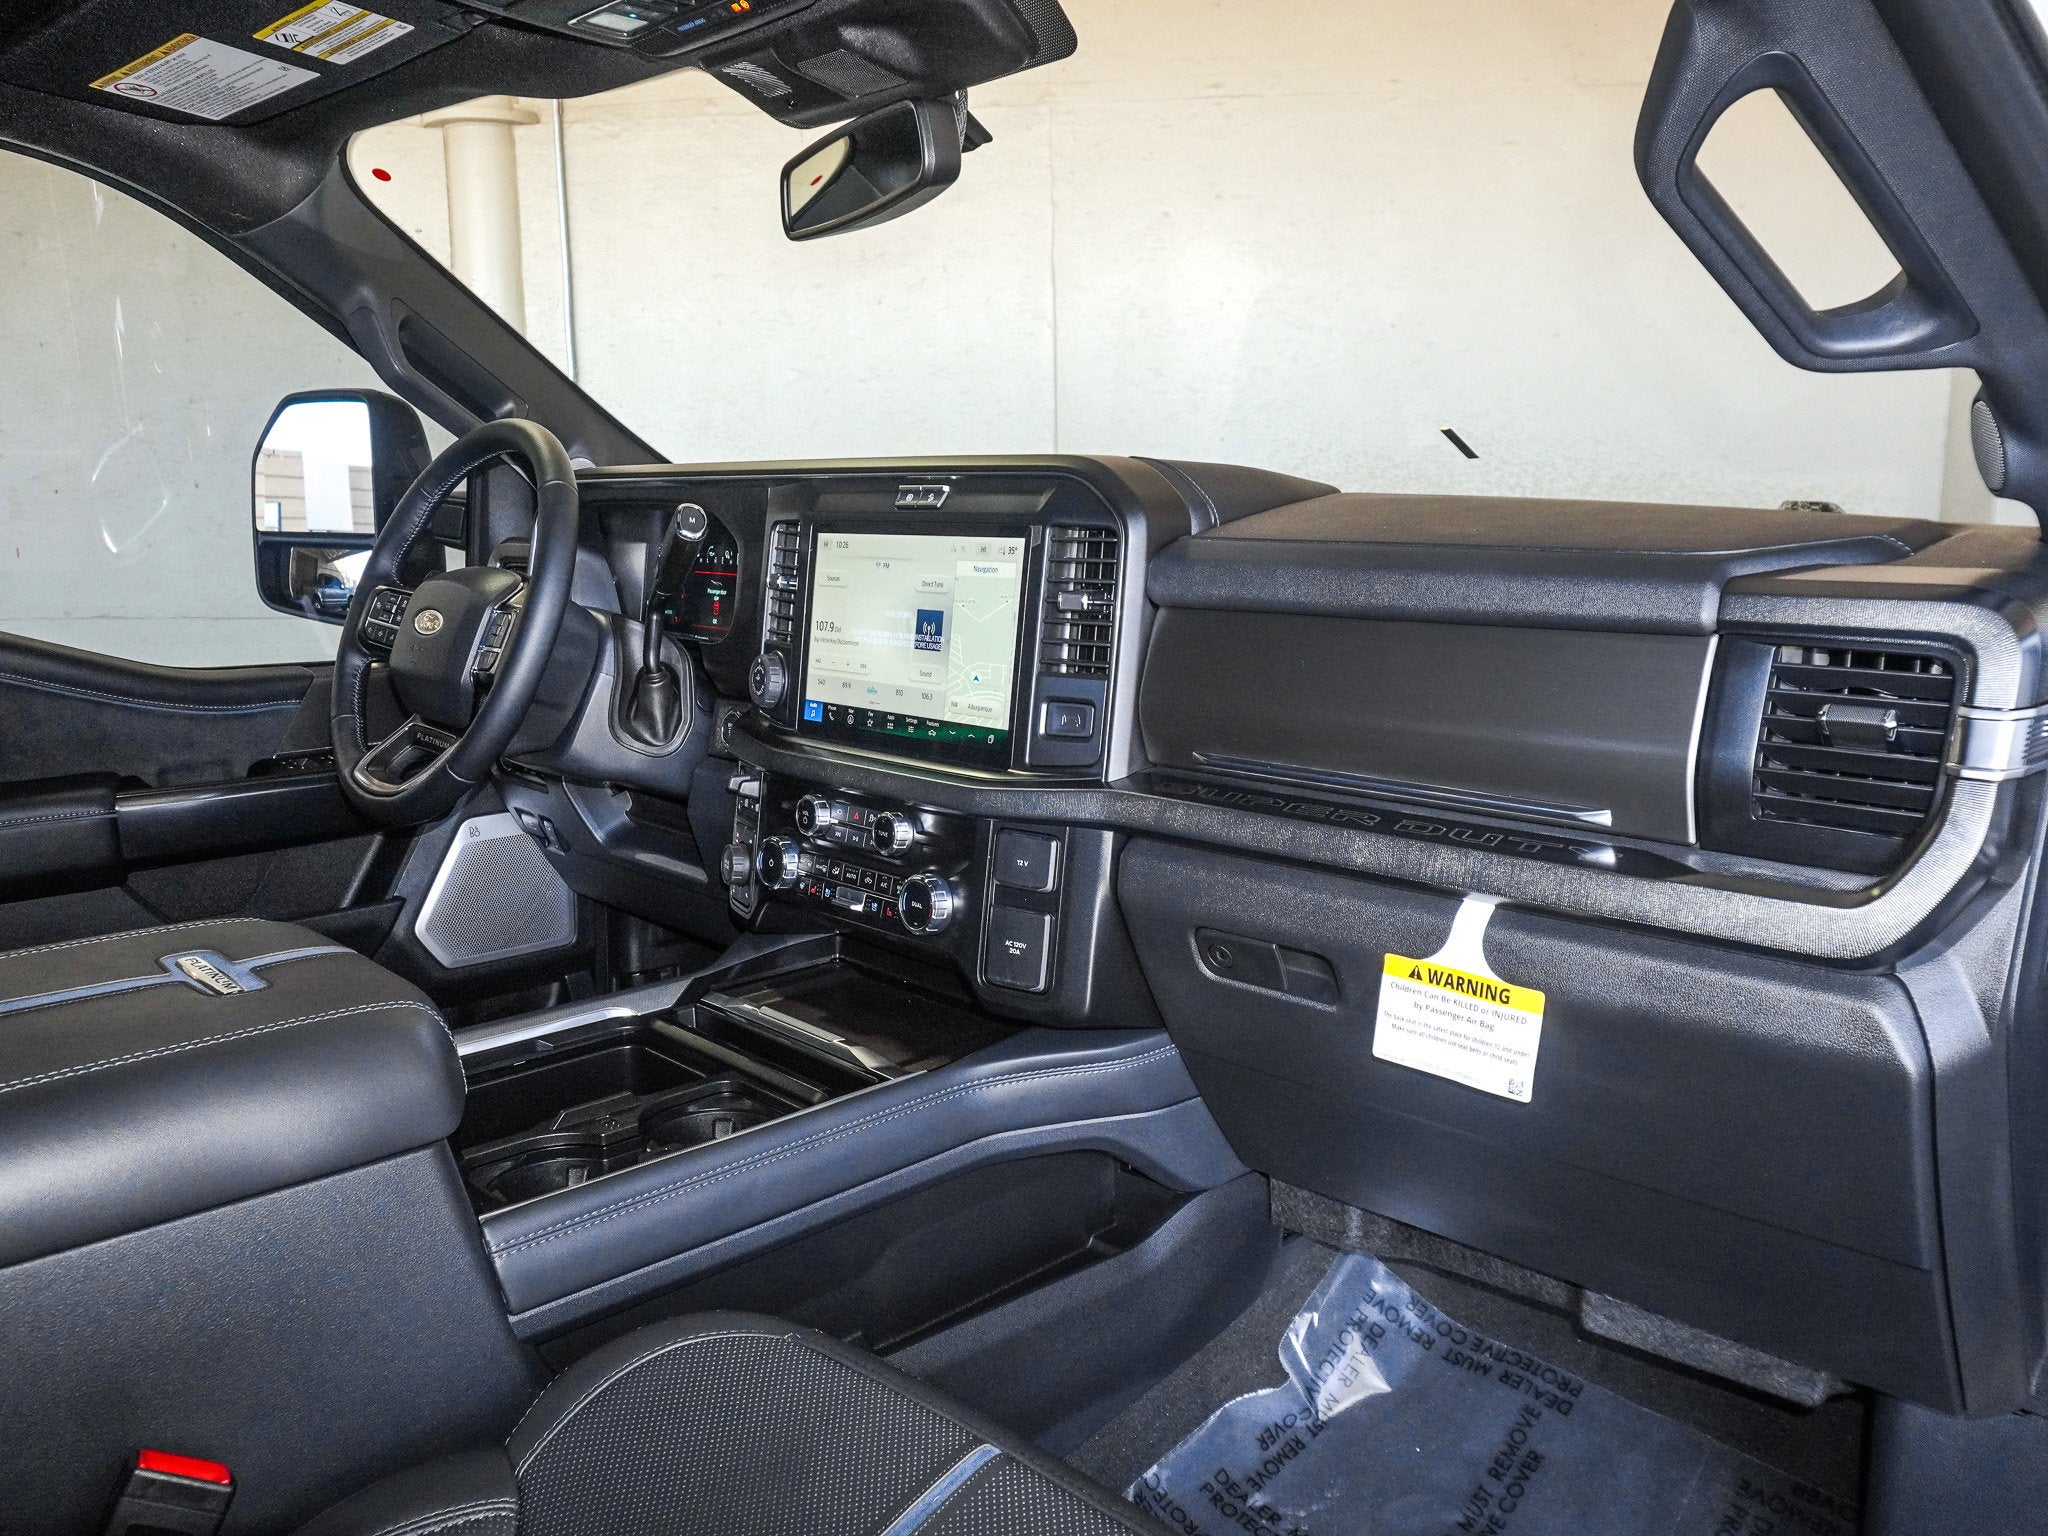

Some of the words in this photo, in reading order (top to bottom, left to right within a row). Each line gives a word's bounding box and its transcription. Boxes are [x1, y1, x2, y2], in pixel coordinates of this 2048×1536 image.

[973, 565, 999, 574] Navigation
[816, 620, 835, 633] 107.9
[919, 670, 932, 678] Sound
[846, 872, 857, 880] AUTO
[911, 901, 923, 909] DUAL
[1009, 947, 1021, 956] 20A
[1013, 941, 1027, 949] 120V
[185, 957, 238, 991] PLATINUM
[1428, 967, 1511, 1005] WARNING
[1390, 981, 1422, 996] Children
[1424, 990, 1439, 1001] Can
[1441, 995, 1451, 1004] Be
[1453, 998, 1479, 1012] KILLED
[1491, 1009, 1527, 1025] INJURED
[1413, 1001, 1423, 1012] by
[1425, 1004, 1464, 1021] Passenger
[1466, 1016, 1477, 1025] Air
[1480, 1020, 1495, 1032] Bag
[1362, 1286, 1437, 1351] REMOVE
[1405, 1293, 1467, 1346] COVER
[1305, 1307, 1369, 1408] PROTECTIV
[1338, 1321, 1386, 1388] DEALER
[1440, 1347, 1493, 1377] MUST
[1470, 1335, 1584, 1398] PROTECTIVE
[1499, 1369, 1575, 1417] DEALER
[1254, 1406, 1313, 1451] COVER
[1246, 1434, 1307, 1493] REMOVE
[1456, 1484, 1493, 1533] MUST
[1487, 1404, 1543, 1483] REMOVE
[1498, 1450, 1546, 1514] COVER
[1199, 1482, 1279, 1536] PROTEC
[1213, 1466, 1283, 1525] DEALER
